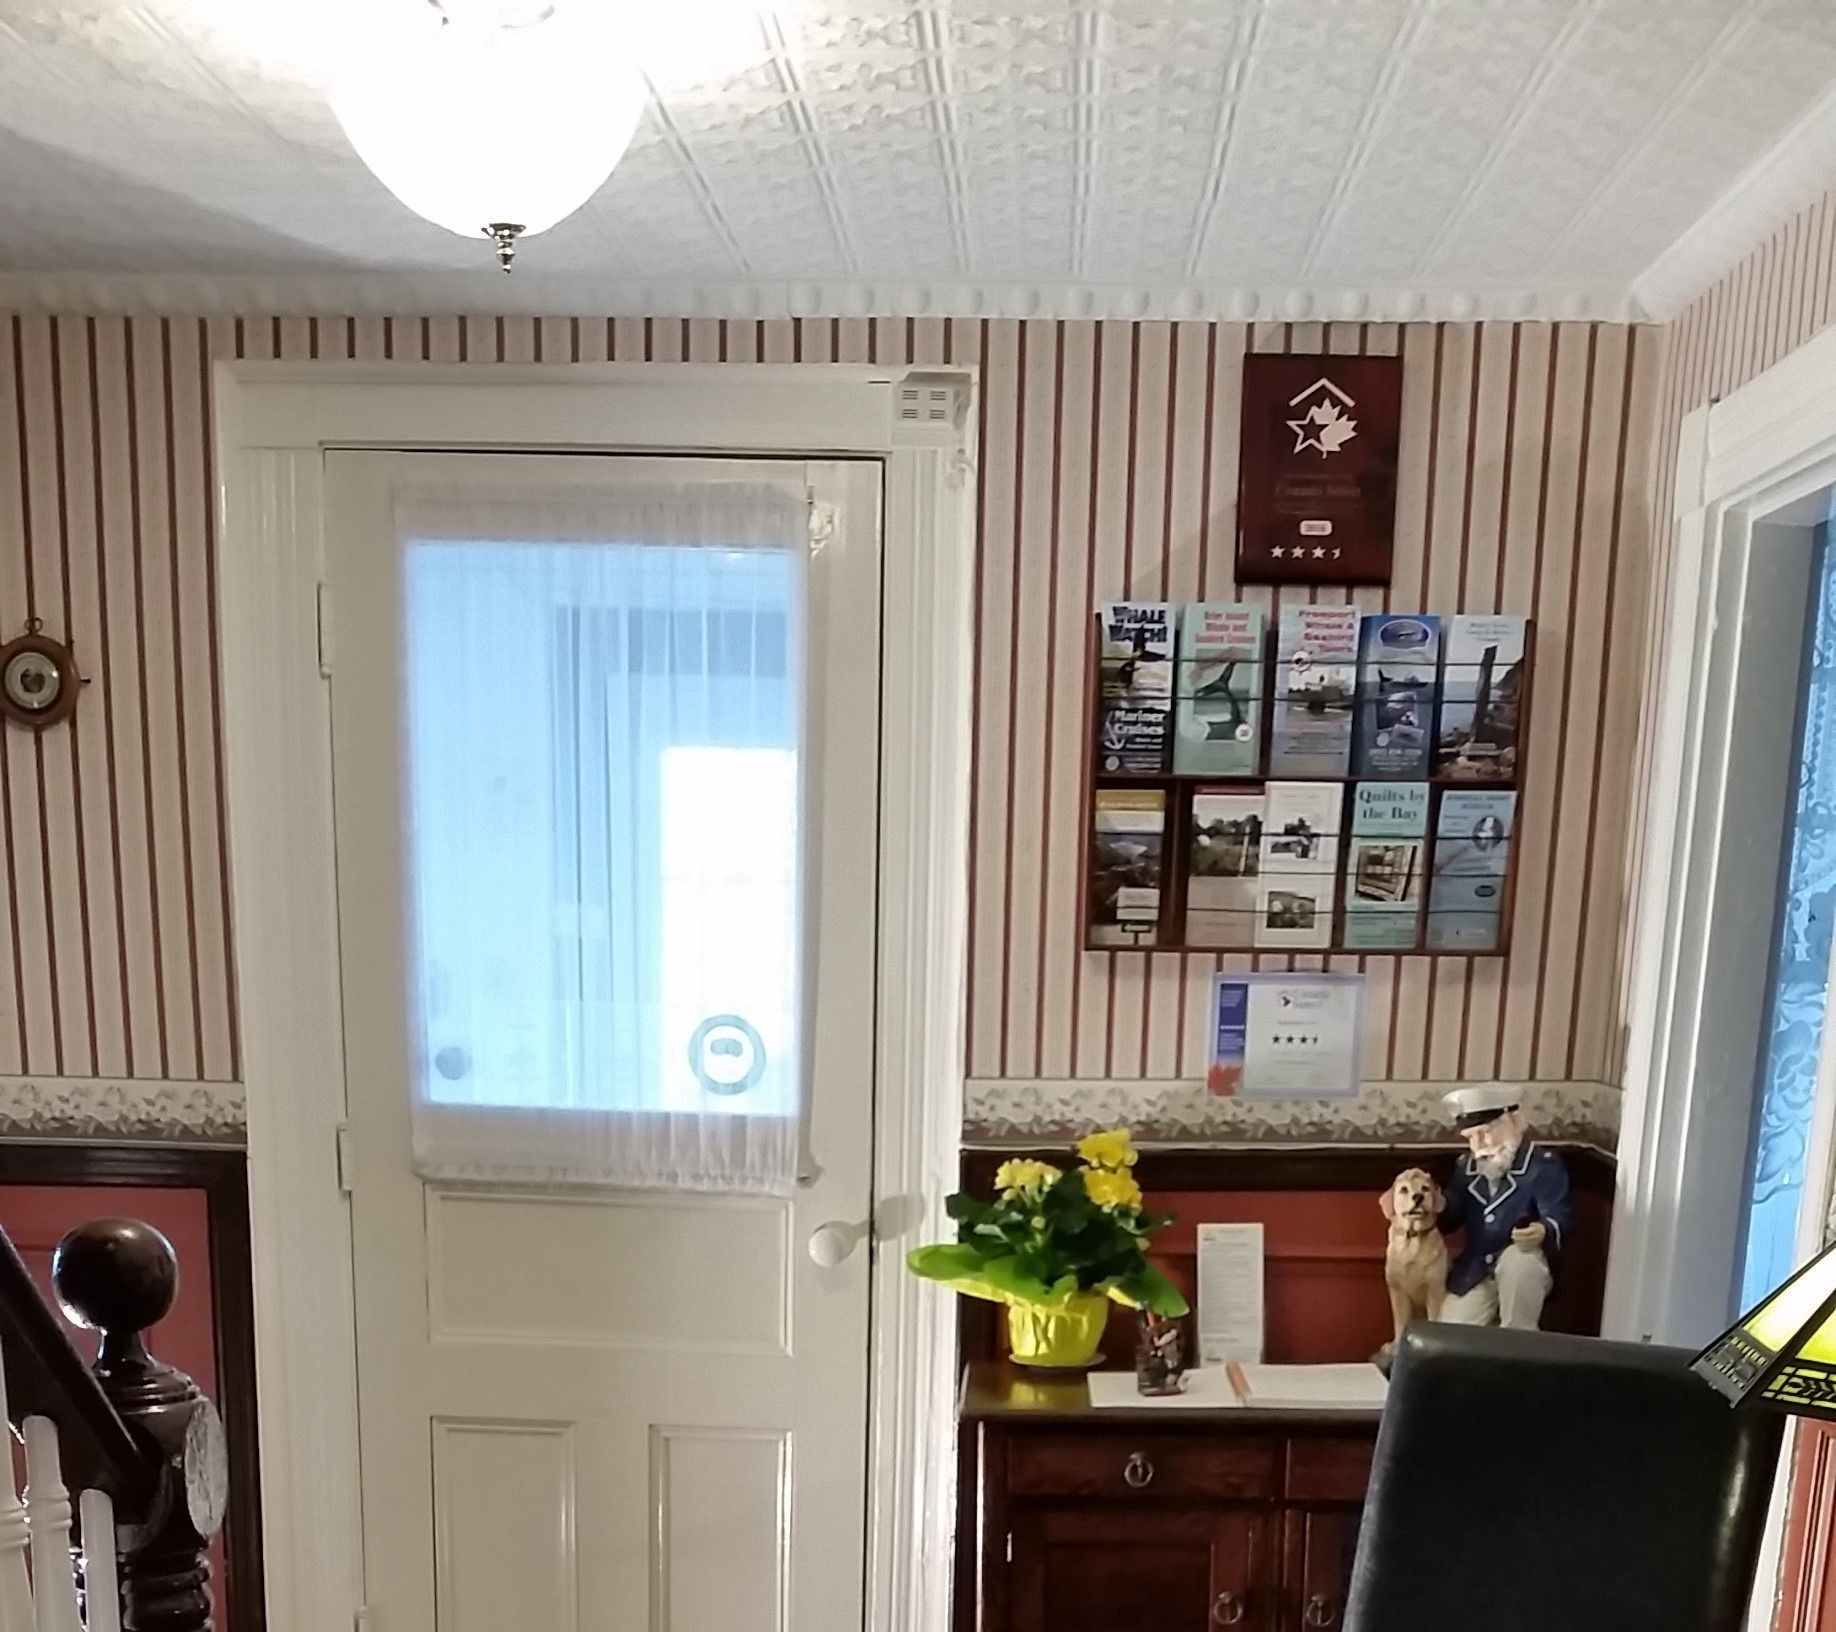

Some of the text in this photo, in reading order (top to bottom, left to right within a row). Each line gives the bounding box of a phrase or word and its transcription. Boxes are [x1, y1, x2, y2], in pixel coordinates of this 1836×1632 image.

[1112, 606, 1167, 625] WHALE
[1114, 723, 1165, 735] Cruises
[1359, 788, 1426, 805] Quilts by
[1363, 806, 1418, 823] the Bay
